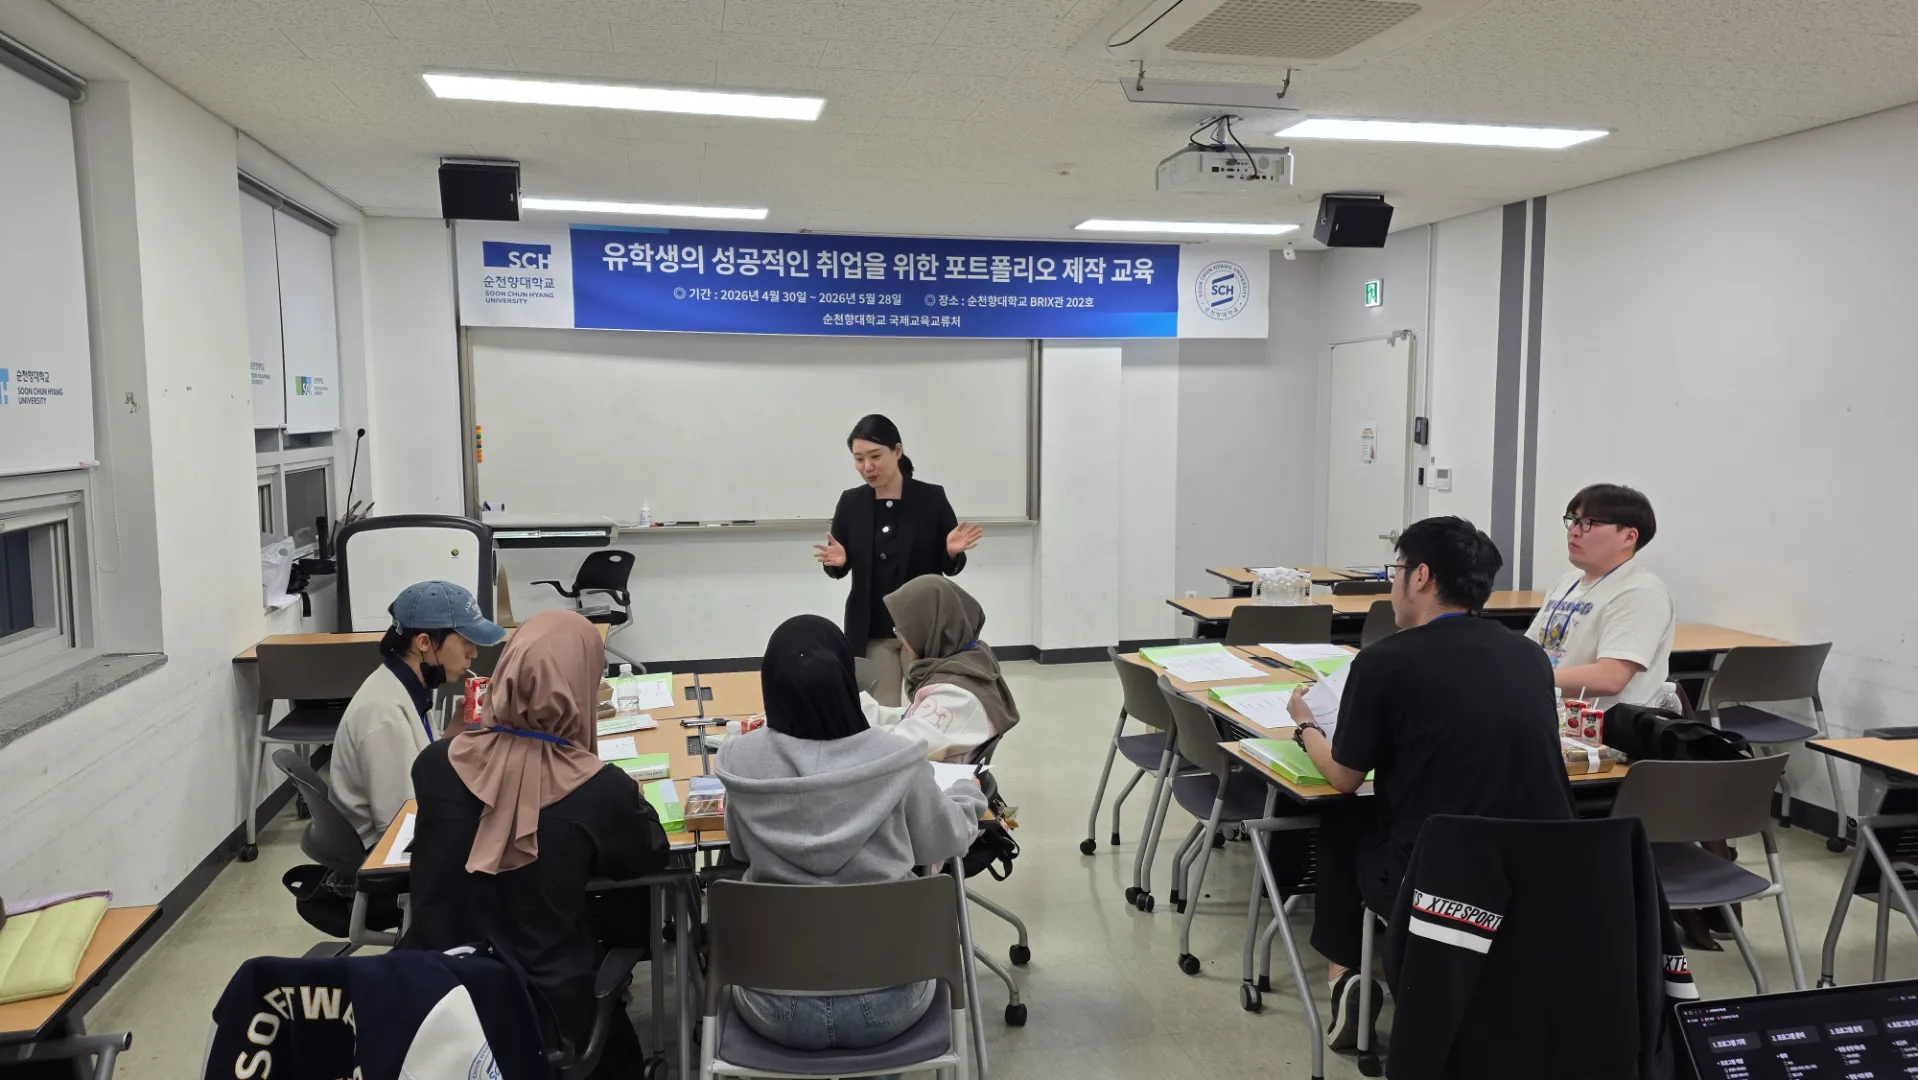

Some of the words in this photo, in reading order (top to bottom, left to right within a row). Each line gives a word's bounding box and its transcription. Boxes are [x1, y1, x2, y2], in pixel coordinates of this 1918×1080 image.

[508, 251, 551, 269] SCH
[602, 242, 704, 274] 유학생의
[712, 246, 809, 278] 성공적인
[816, 250, 887, 280] 취업을
[893, 252, 939, 281] 위한
[944, 255, 1057, 283] 포트폴리오
[1062, 257, 1106, 284] 제작
[1111, 258, 1154, 284] 교육
[483, 275, 555, 289] 순천향대학교
[689, 288, 711, 301] 기간
[720, 289, 759, 302] 2026년
[762, 290, 779, 303] 4월
[782, 291, 807, 303] 30일
[819, 292, 856, 304] 2026년
[858, 293, 876, 305] 5월
[878, 293, 902, 306] 28일
[1211, 285, 1234, 295] SCH
[938, 294, 959, 307] 장소
[967, 295, 1027, 307] 순천향대학교
[1030, 296, 1064, 308] BRIX관
[1066, 296, 1094, 308] 202호
[822, 313, 886, 326] 순천향대학교
[888, 314, 961, 328] 국제교육교류처
[16, 369, 50, 383] 순천향대학교
[17, 387, 33, 395] SOON
[33, 387, 47, 396] CHUN
[47, 388, 64, 396] HYANG
[18, 396, 47, 405] UNIVERSITY
